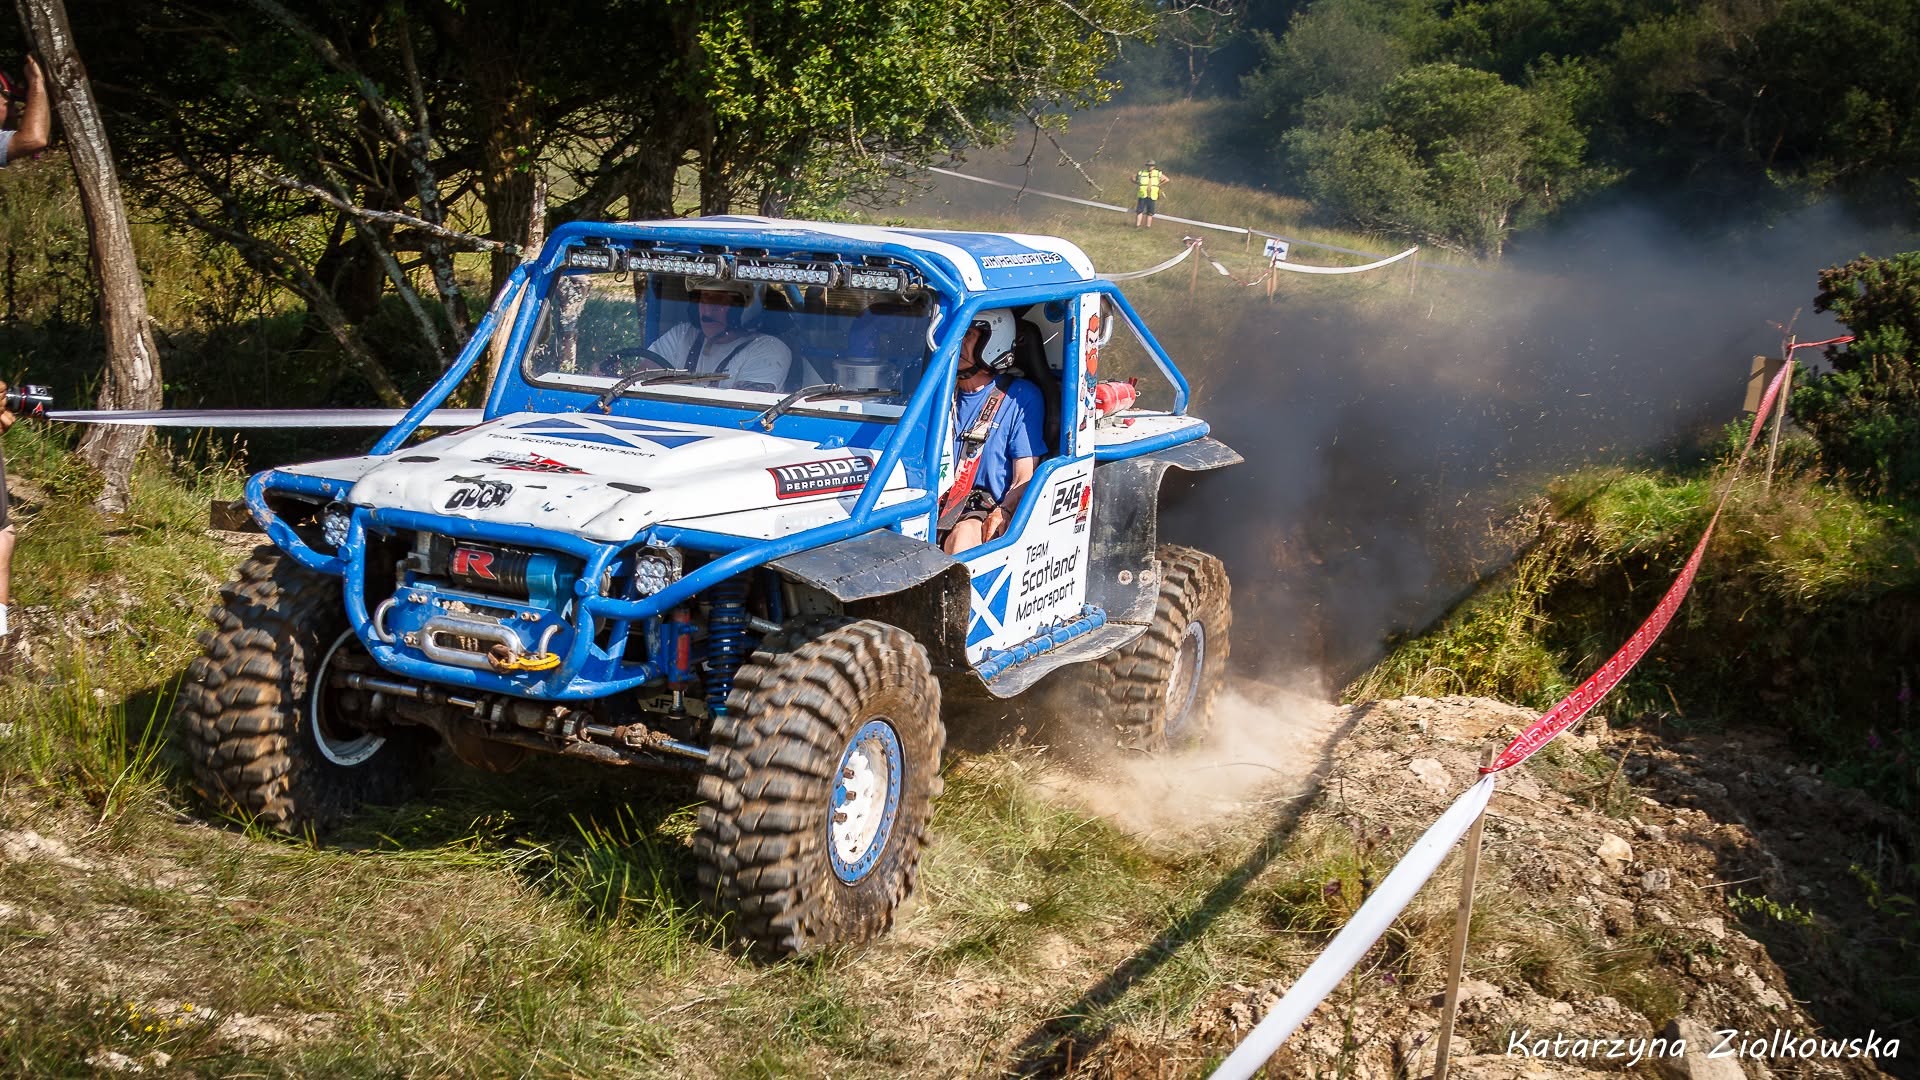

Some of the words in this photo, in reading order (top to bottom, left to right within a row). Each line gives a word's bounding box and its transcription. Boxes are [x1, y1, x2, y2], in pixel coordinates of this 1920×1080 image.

[486, 433, 517, 441] TEAM
[520, 436, 578, 448] Scotland
[580, 443, 656, 458] Motorsport
[777, 458, 868, 481] INSIDE
[786, 473, 870, 491] PERFORMANCE
[1051, 481, 1083, 517] 245
[452, 548, 497, 580] R
[1026, 540, 1050, 565] TEAM
[1020, 546, 1080, 597] Scotland
[1015, 577, 1076, 623] Motorsport
